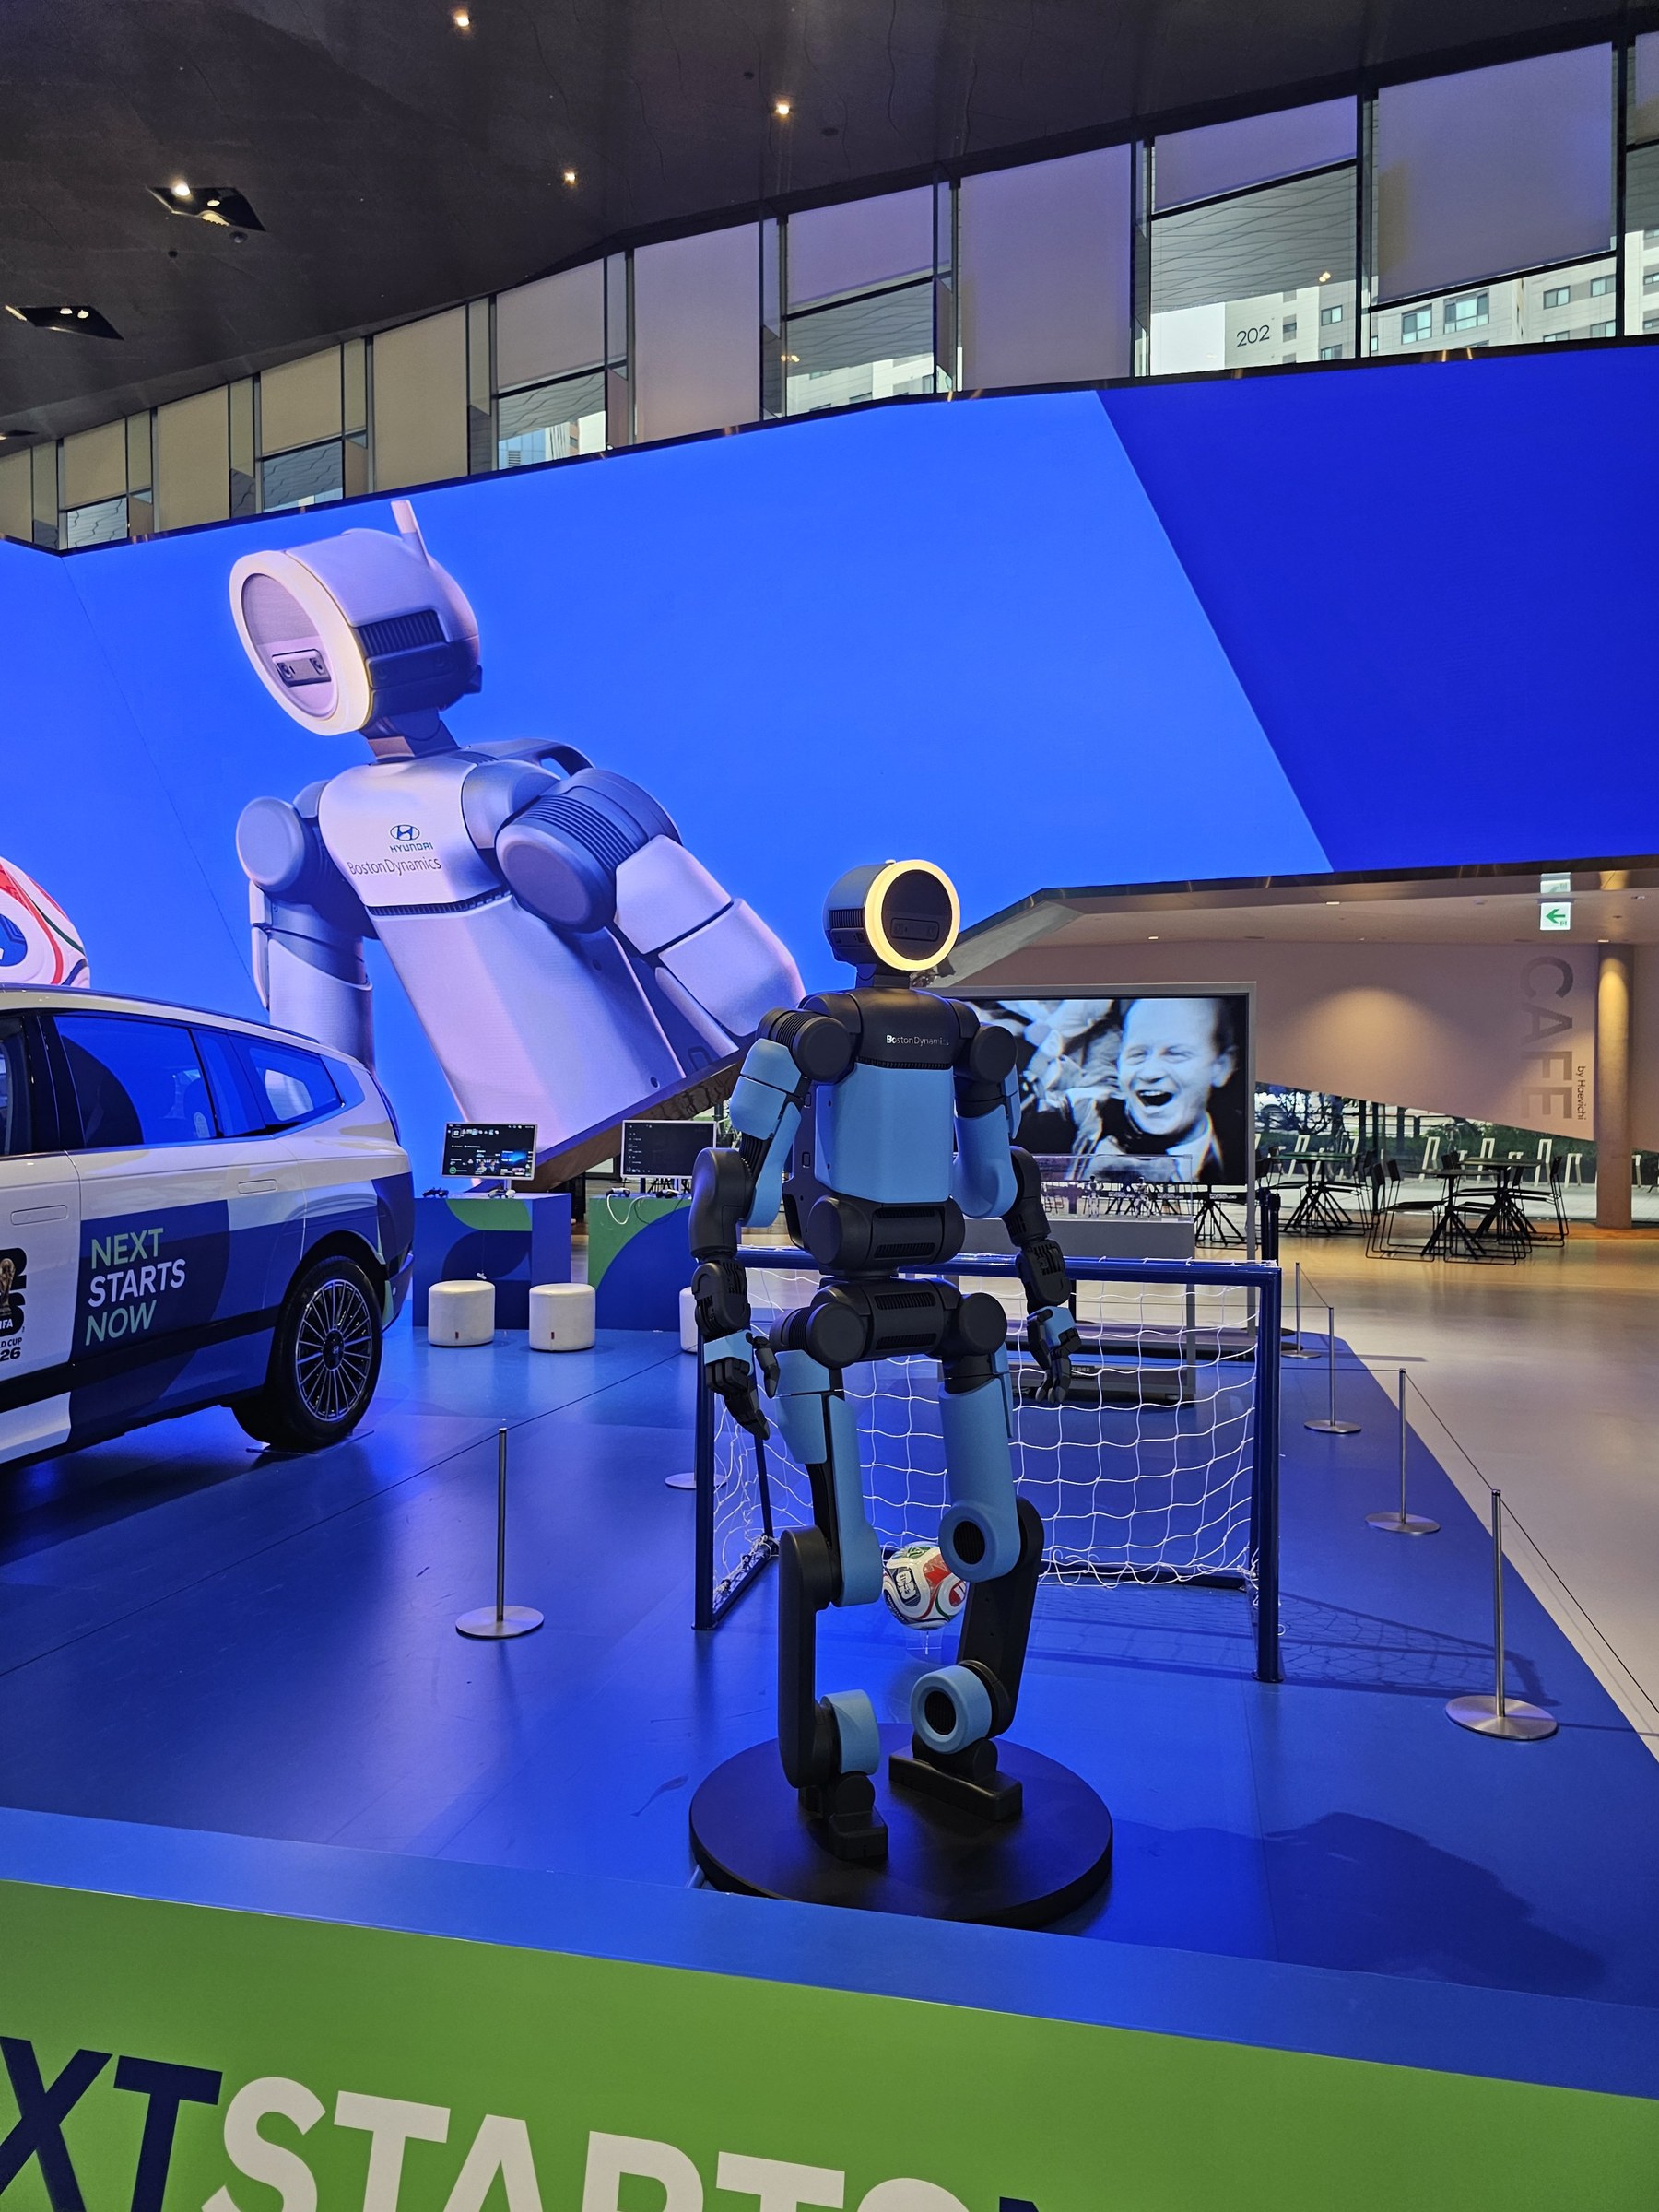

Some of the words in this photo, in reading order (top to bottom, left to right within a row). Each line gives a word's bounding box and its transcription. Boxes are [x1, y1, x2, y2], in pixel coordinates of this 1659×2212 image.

[1236, 324, 1270, 347] 202
[390, 842, 433, 853] HYUNDAI
[347, 857, 441, 876] BostonDynamics
[886, 1034, 949, 1047] BostonDynami
[1520, 956, 1574, 1119] CAFE
[1575, 1065, 1586, 1077] by
[1577, 1080, 1586, 1120] Haevichi
[91, 1228, 164, 1269] NEXT
[88, 1259, 186, 1307] STARTS
[85, 1300, 157, 1346] NOW
